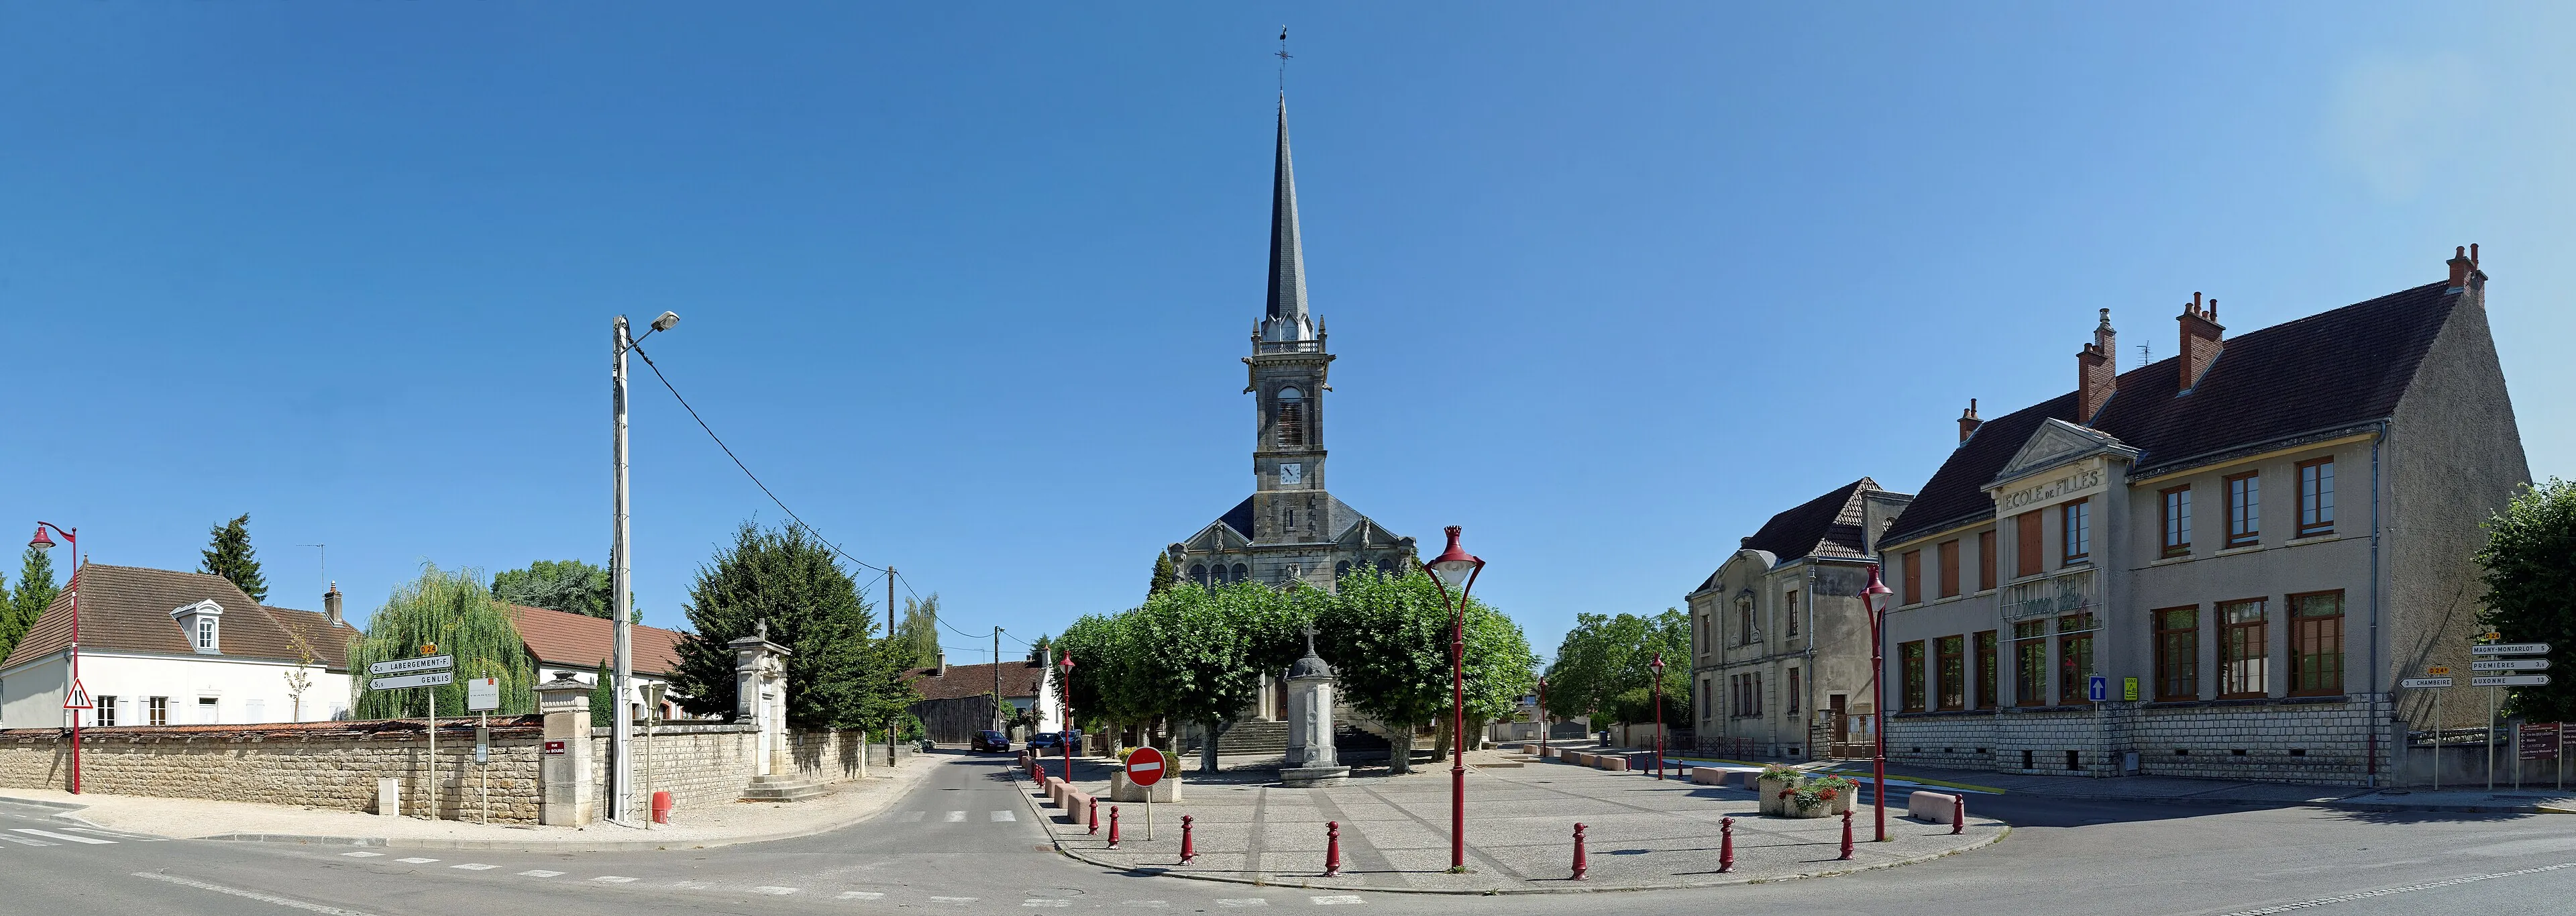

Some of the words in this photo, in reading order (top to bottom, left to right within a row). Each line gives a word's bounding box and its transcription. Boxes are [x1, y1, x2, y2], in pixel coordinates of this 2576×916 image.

[2004, 486, 2043, 511] ECOLE
[2045, 489, 2054, 499] DE
[2056, 470, 2098, 497] FILLES
[390, 658, 449, 670] LABERGEMENT-F.
[421, 675, 449, 683] GENLIS
